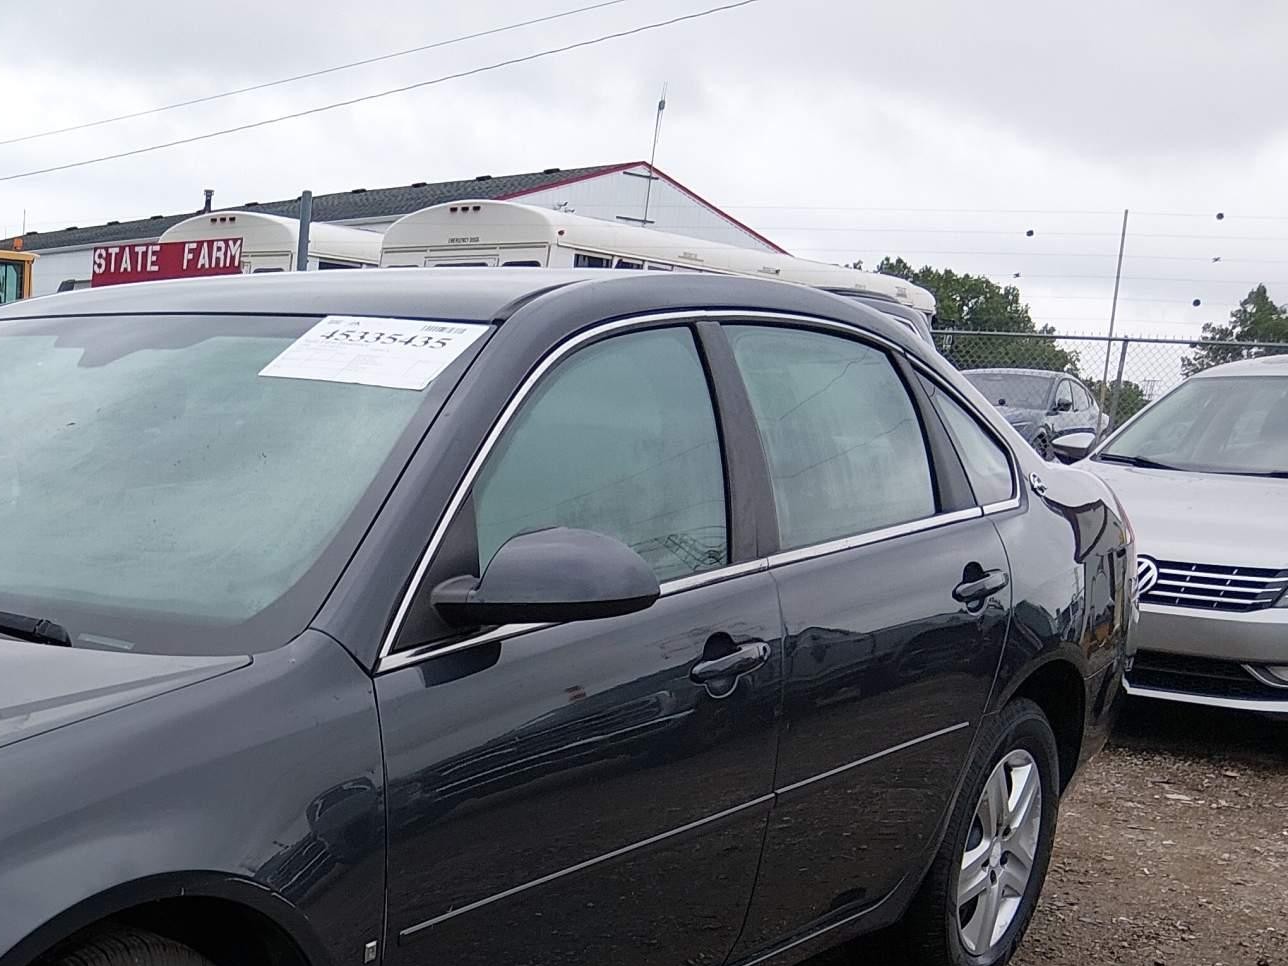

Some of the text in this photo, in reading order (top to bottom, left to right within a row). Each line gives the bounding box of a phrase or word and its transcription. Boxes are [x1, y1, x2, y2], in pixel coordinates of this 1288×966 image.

[93, 239, 242, 274] STATE FARM
[320, 328, 453, 350] 45335435
